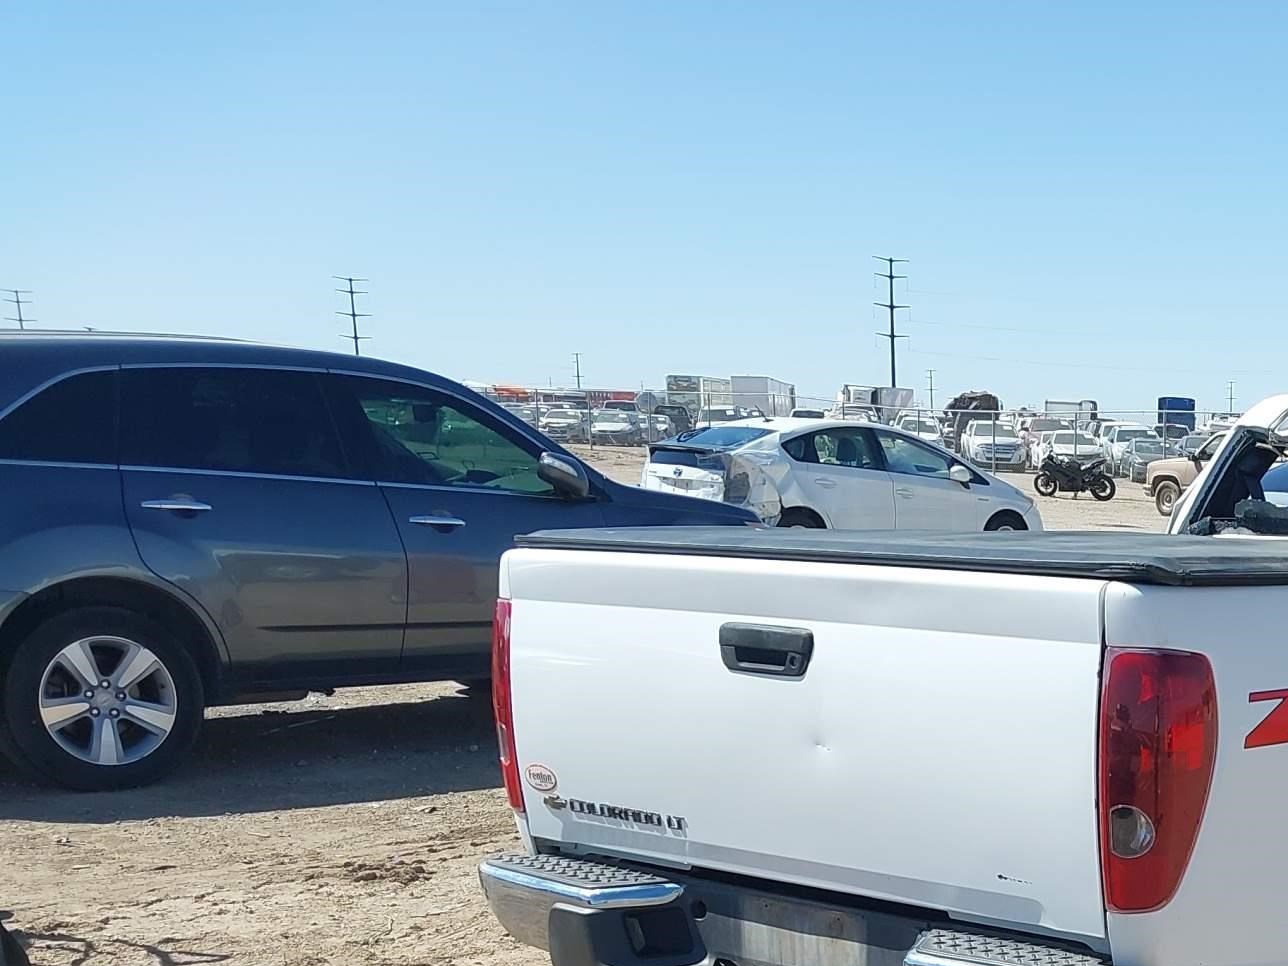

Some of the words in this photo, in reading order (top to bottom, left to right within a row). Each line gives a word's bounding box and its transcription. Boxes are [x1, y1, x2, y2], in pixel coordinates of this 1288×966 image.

[528, 768, 553, 782] Fenton
[569, 799, 662, 827] COLORADO
[667, 815, 687, 831] LT
